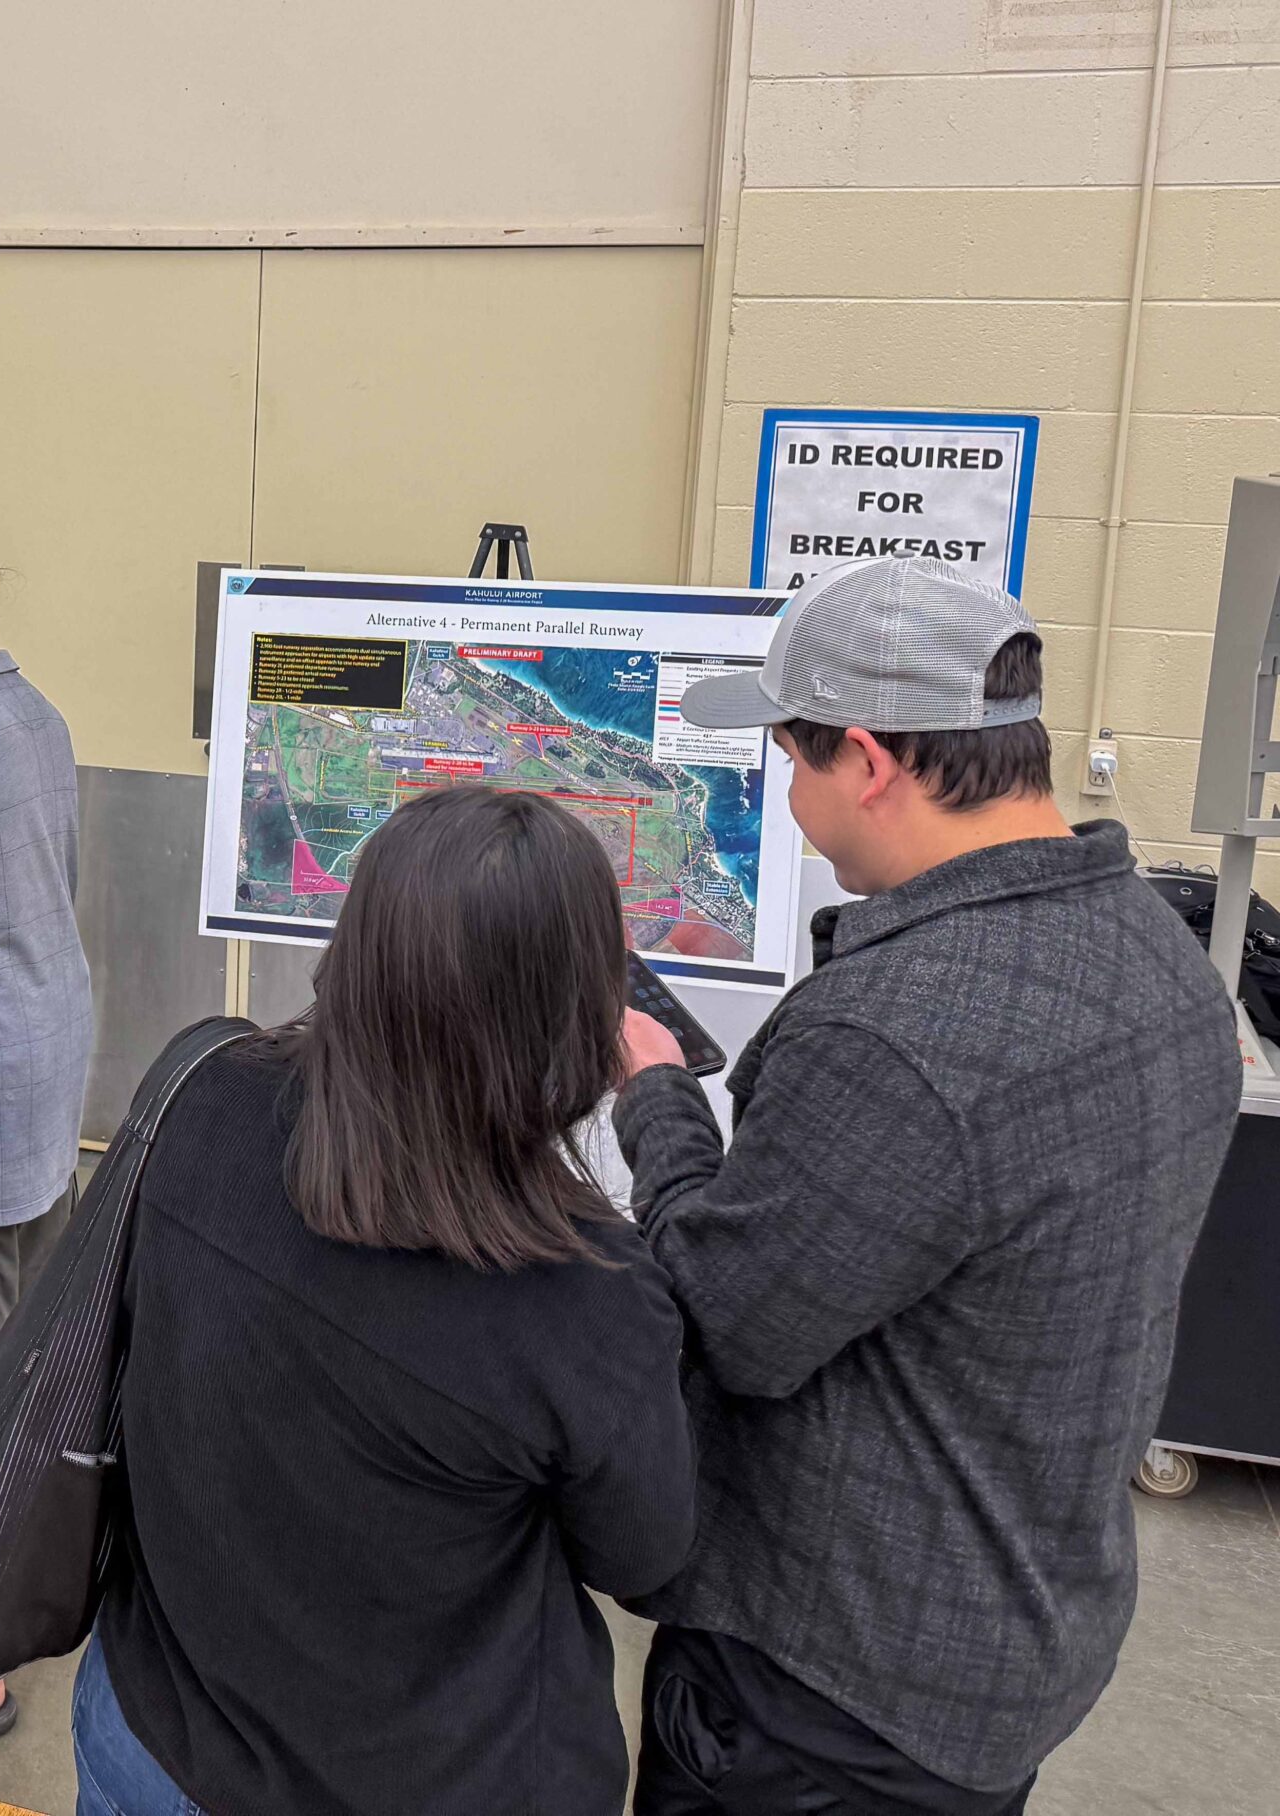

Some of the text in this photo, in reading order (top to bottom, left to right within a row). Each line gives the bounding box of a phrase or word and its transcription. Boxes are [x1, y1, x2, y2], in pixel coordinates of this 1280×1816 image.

[788, 444, 1004, 470] ID REQUIRED
[857, 491, 924, 514] FOR
[465, 590, 543, 599] KAHULUI AIRPORT
[366, 613, 437, 628] Alternative
[440, 617, 447, 629] 4
[461, 618, 531, 633] Permanent
[536, 621, 584, 635] Parallel
[590, 624, 644, 641] Runway
[464, 649, 538, 658] PRELIMINARY DRAFT
